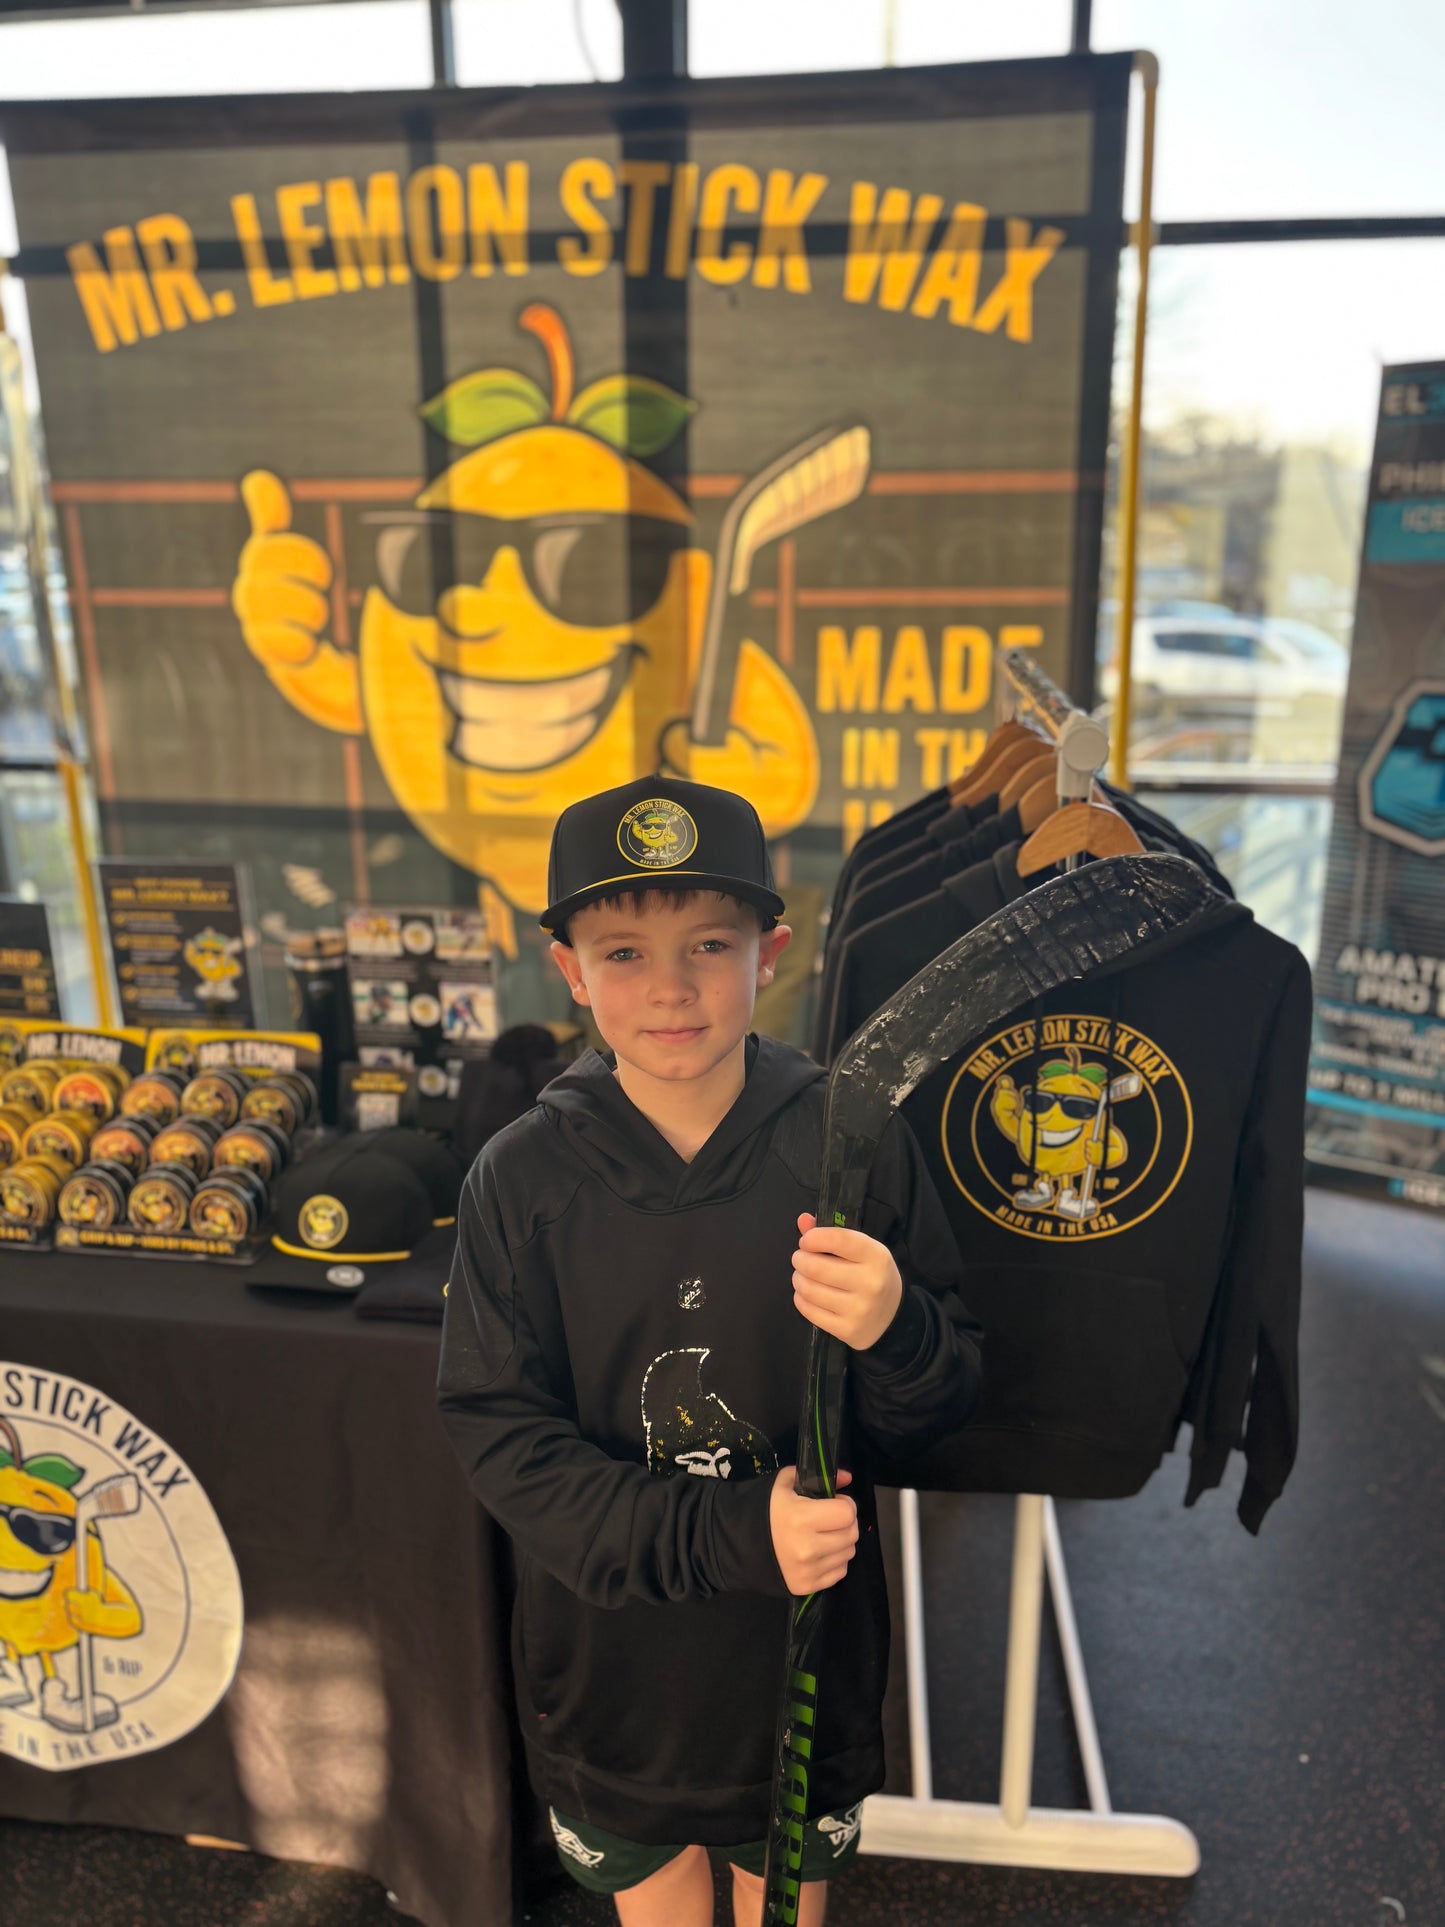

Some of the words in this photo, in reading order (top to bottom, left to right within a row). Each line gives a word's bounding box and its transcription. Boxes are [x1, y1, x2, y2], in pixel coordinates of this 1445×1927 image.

[66, 213, 235, 353] MR.
[230, 160, 530, 308] LEMON
[557, 157, 828, 294] STICK
[844, 180, 1066, 343] WAX
[842, 727, 899, 790] IN
[632, 802, 654, 815] LEMON
[654, 801, 673, 809] STICK
[672, 805, 686, 818] WAX
[968, 1049, 1006, 1081] MR.
[1128, 1041, 1171, 1085] WAX
[995, 1204, 1033, 1230] MADE
[1036, 1220, 1053, 1235] IN
[1059, 1221, 1085, 1236] THE
[1090, 1213, 1118, 1232] USA
[5, 1370, 111, 1435] STICK
[114, 1420, 189, 1497] WAX
[18, 1732, 38, 1756] IN
[52, 1735, 98, 1762] THE
[109, 1721, 154, 1750] USA
